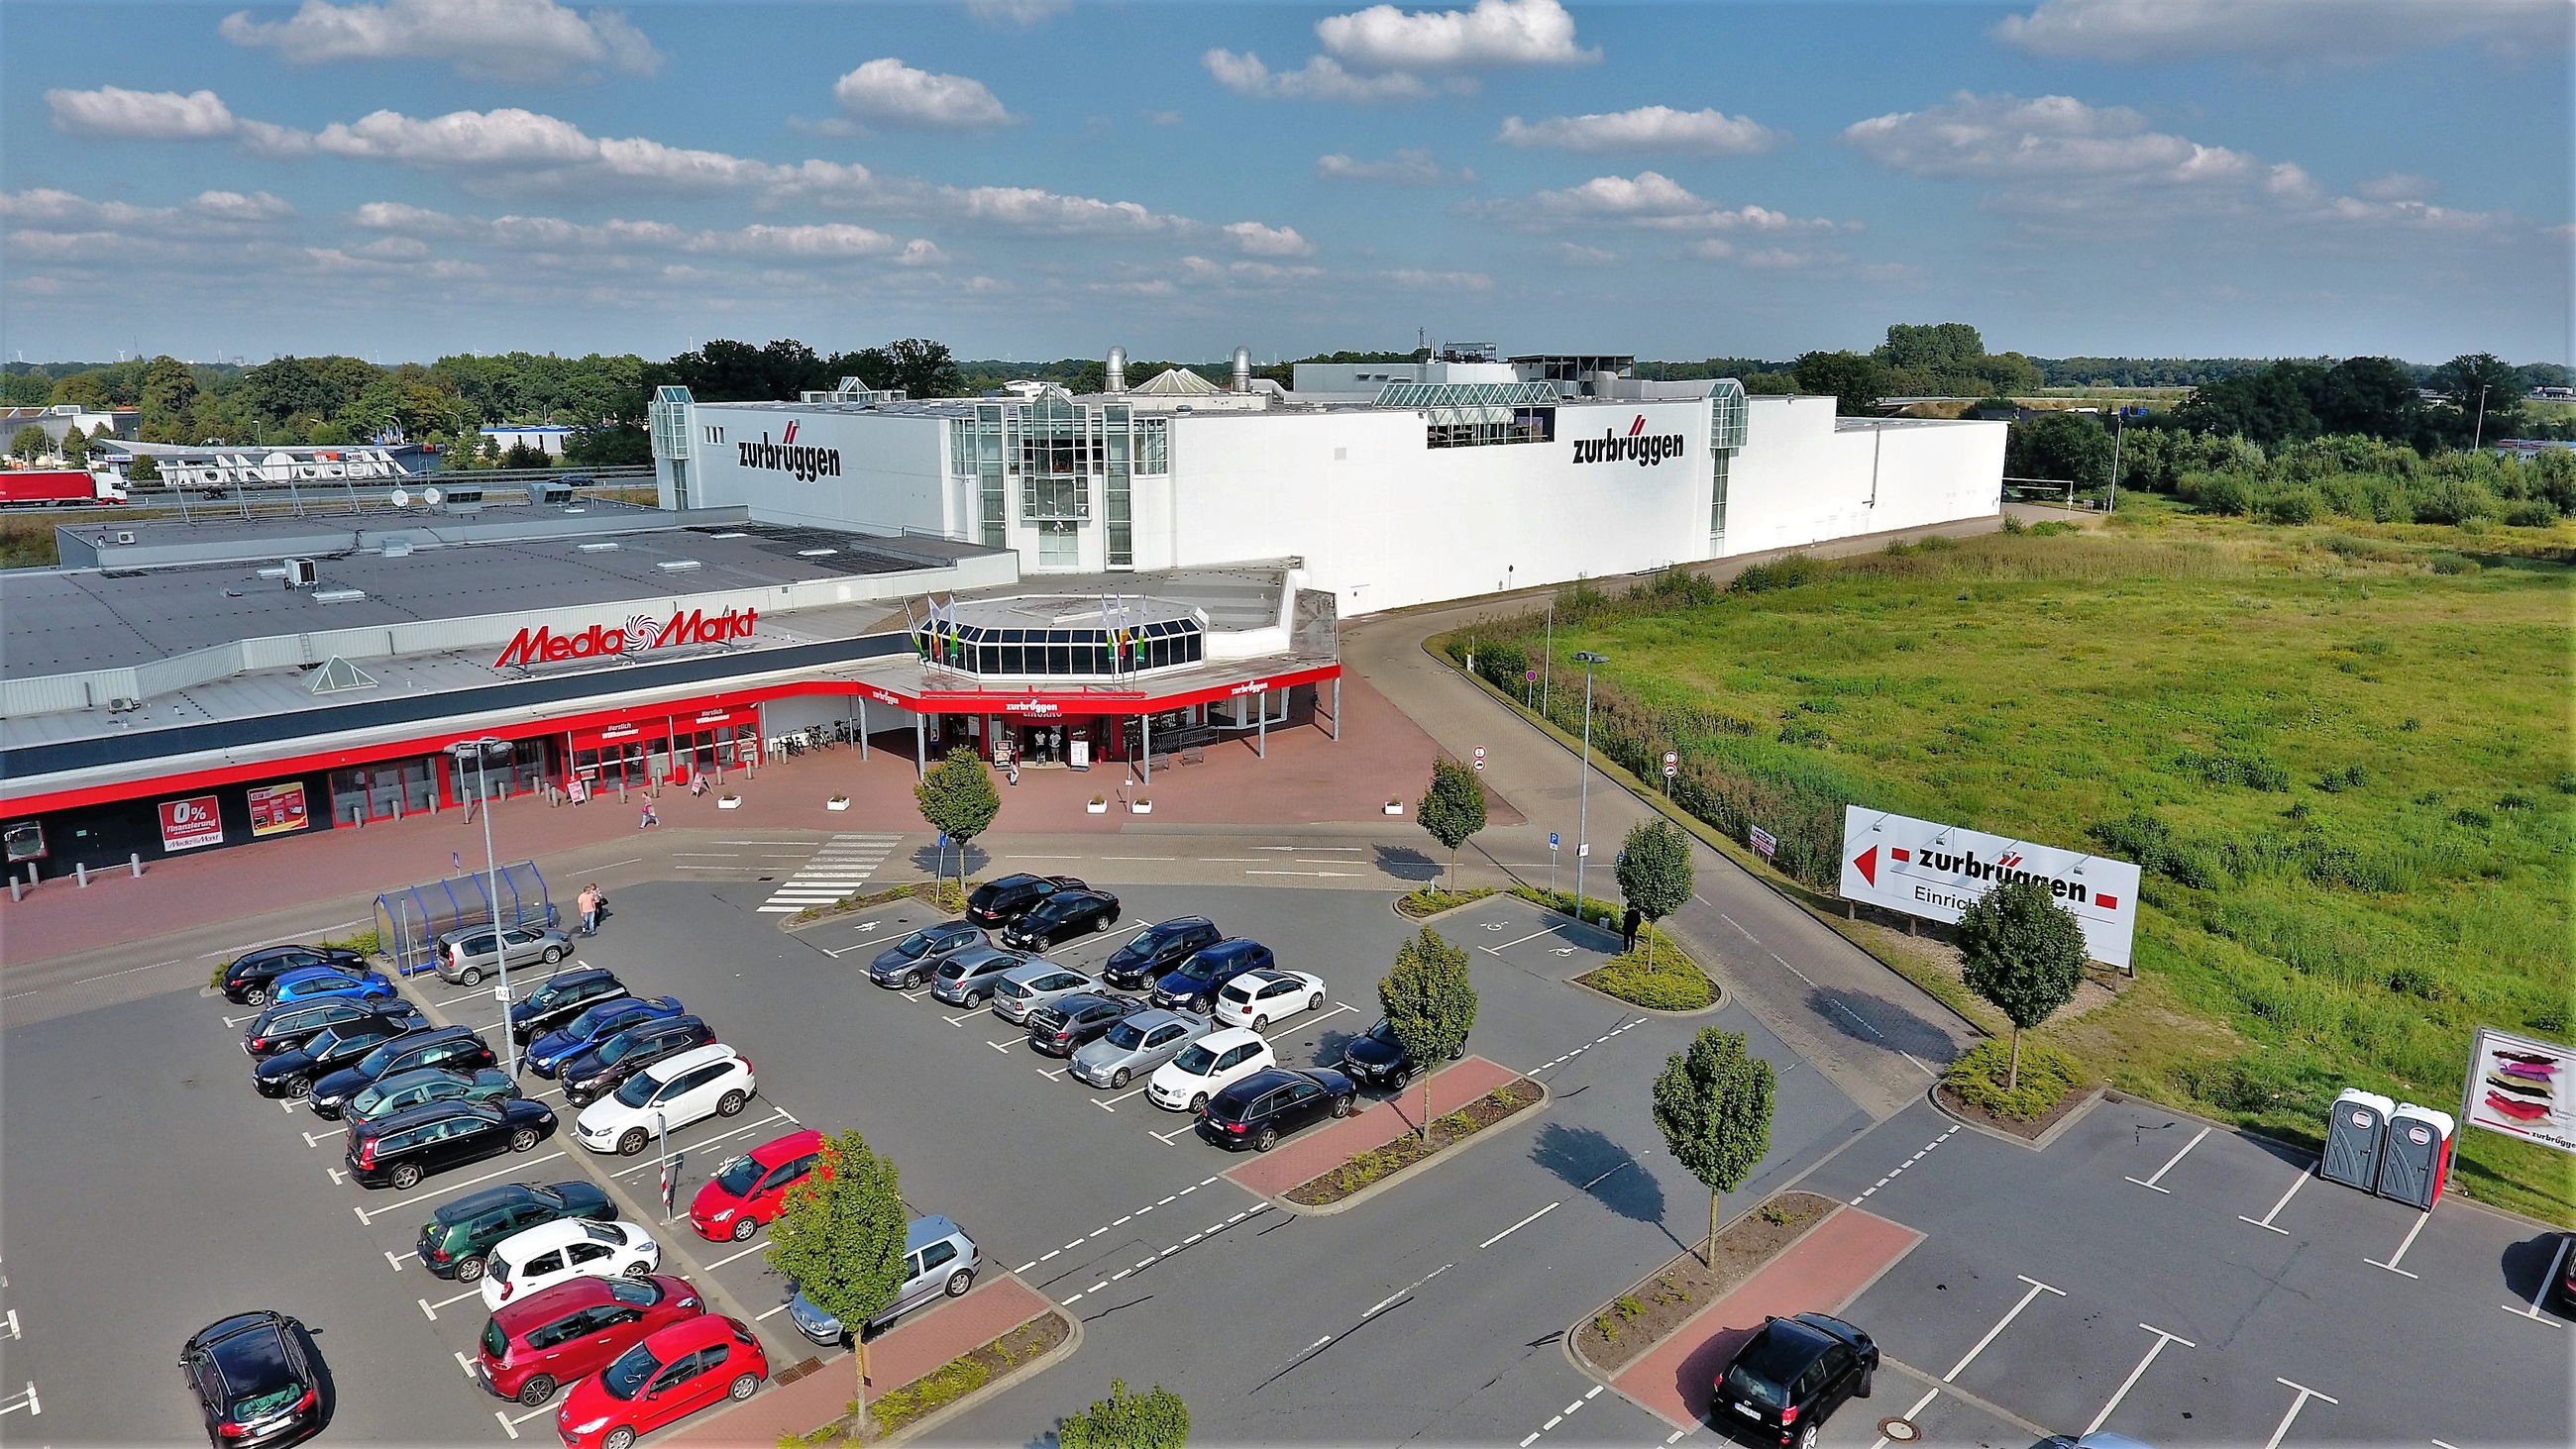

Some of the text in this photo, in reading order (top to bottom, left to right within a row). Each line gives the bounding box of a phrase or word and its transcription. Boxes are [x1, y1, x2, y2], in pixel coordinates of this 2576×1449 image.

[738, 420, 841, 482] zurbrüggen
[1572, 414, 1684, 466] zurbrüggen
[493, 607, 759, 668] Media Markt
[1006, 698, 1058, 713] zurbrüggen
[173, 802, 207, 824] 0%
[497, 989, 508, 998] A2
[2531, 1131, 2576, 1149] zurbrügge
